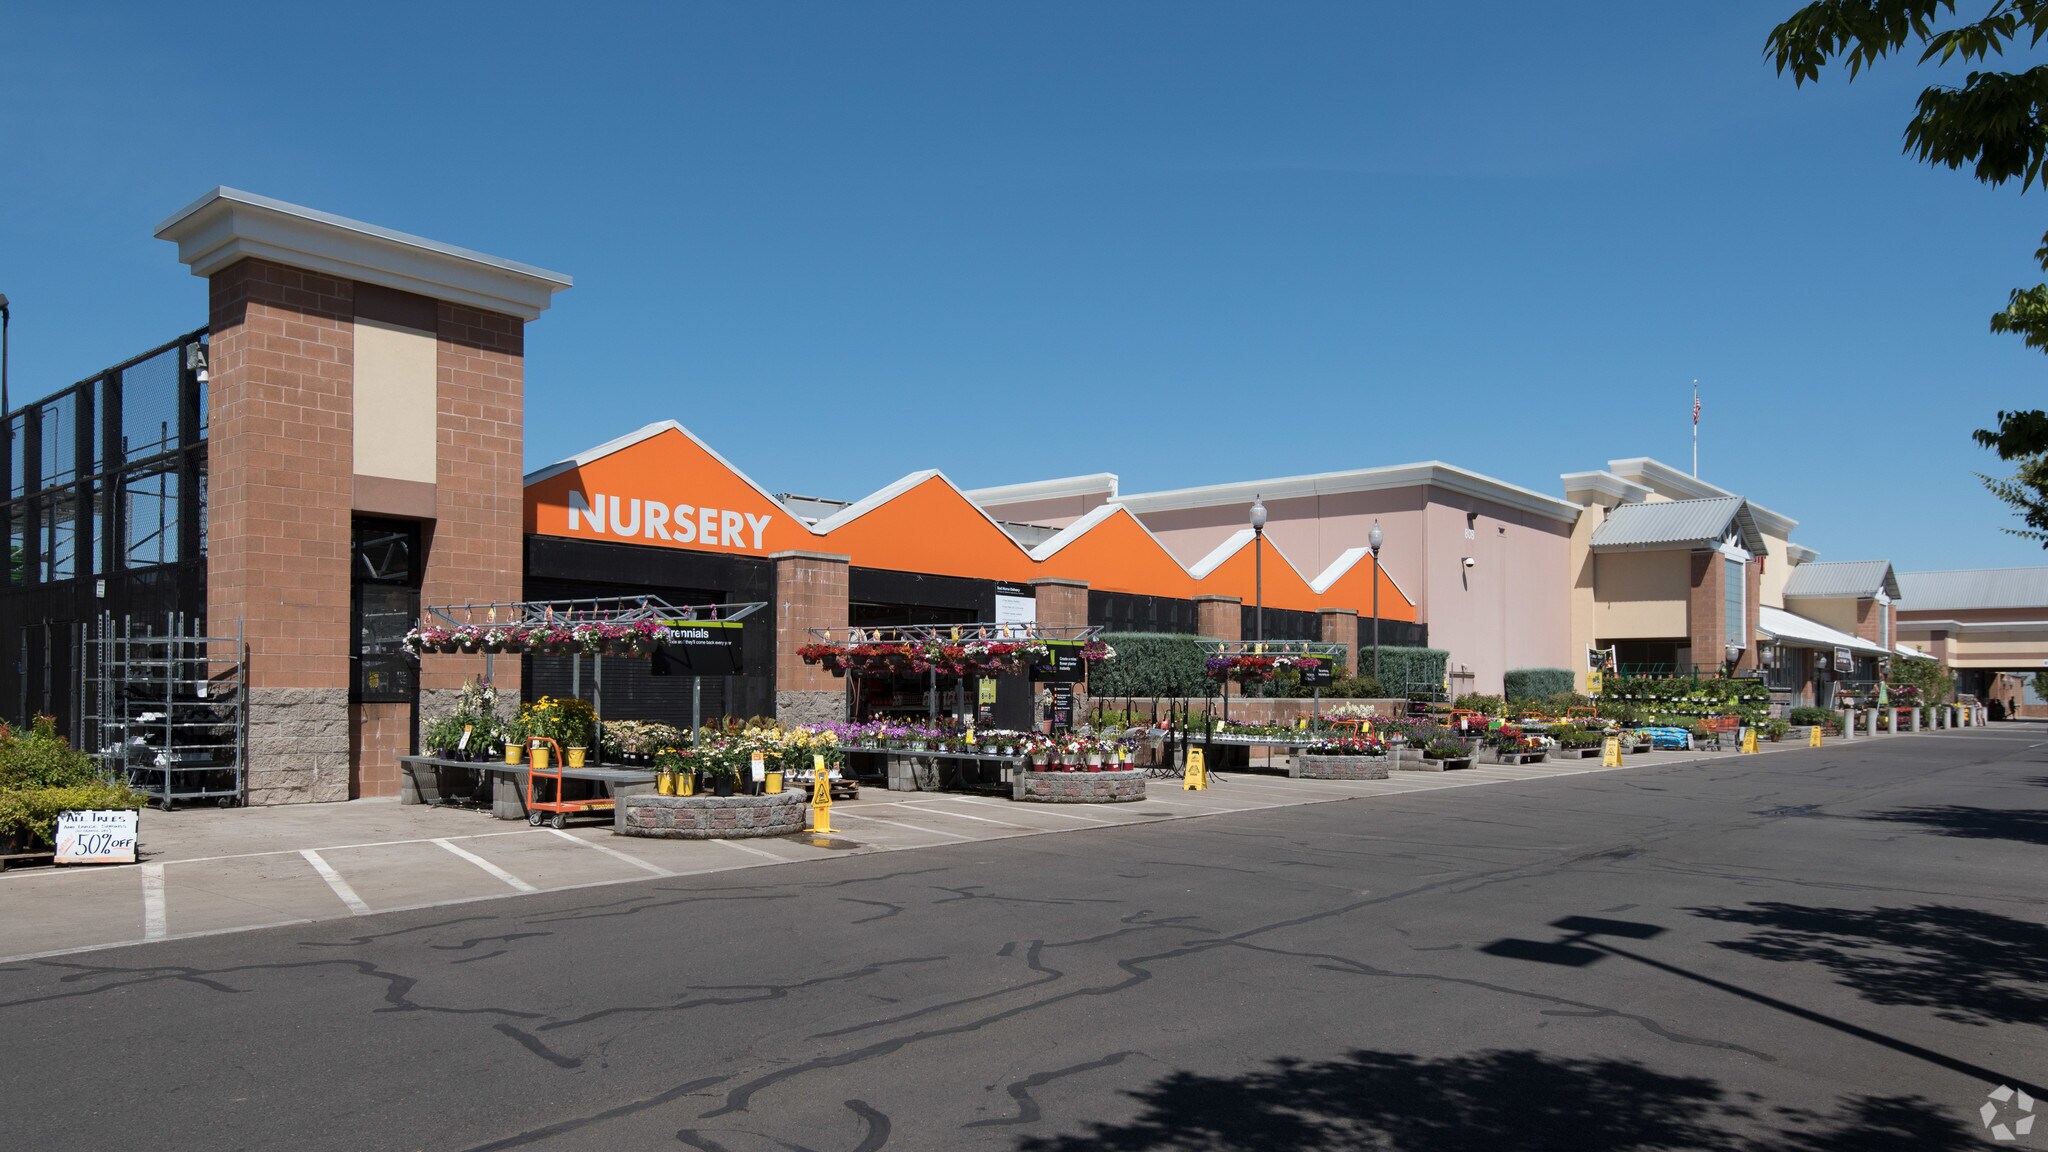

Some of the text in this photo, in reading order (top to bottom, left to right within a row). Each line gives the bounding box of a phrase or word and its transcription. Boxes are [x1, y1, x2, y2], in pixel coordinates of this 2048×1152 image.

[569, 490, 772, 549] NURSERY
[671, 628, 709, 638] rennials
[66, 812, 126, 822] ALL TREES
[75, 834, 112, 856] 50%
[111, 838, 133, 848] OFF
